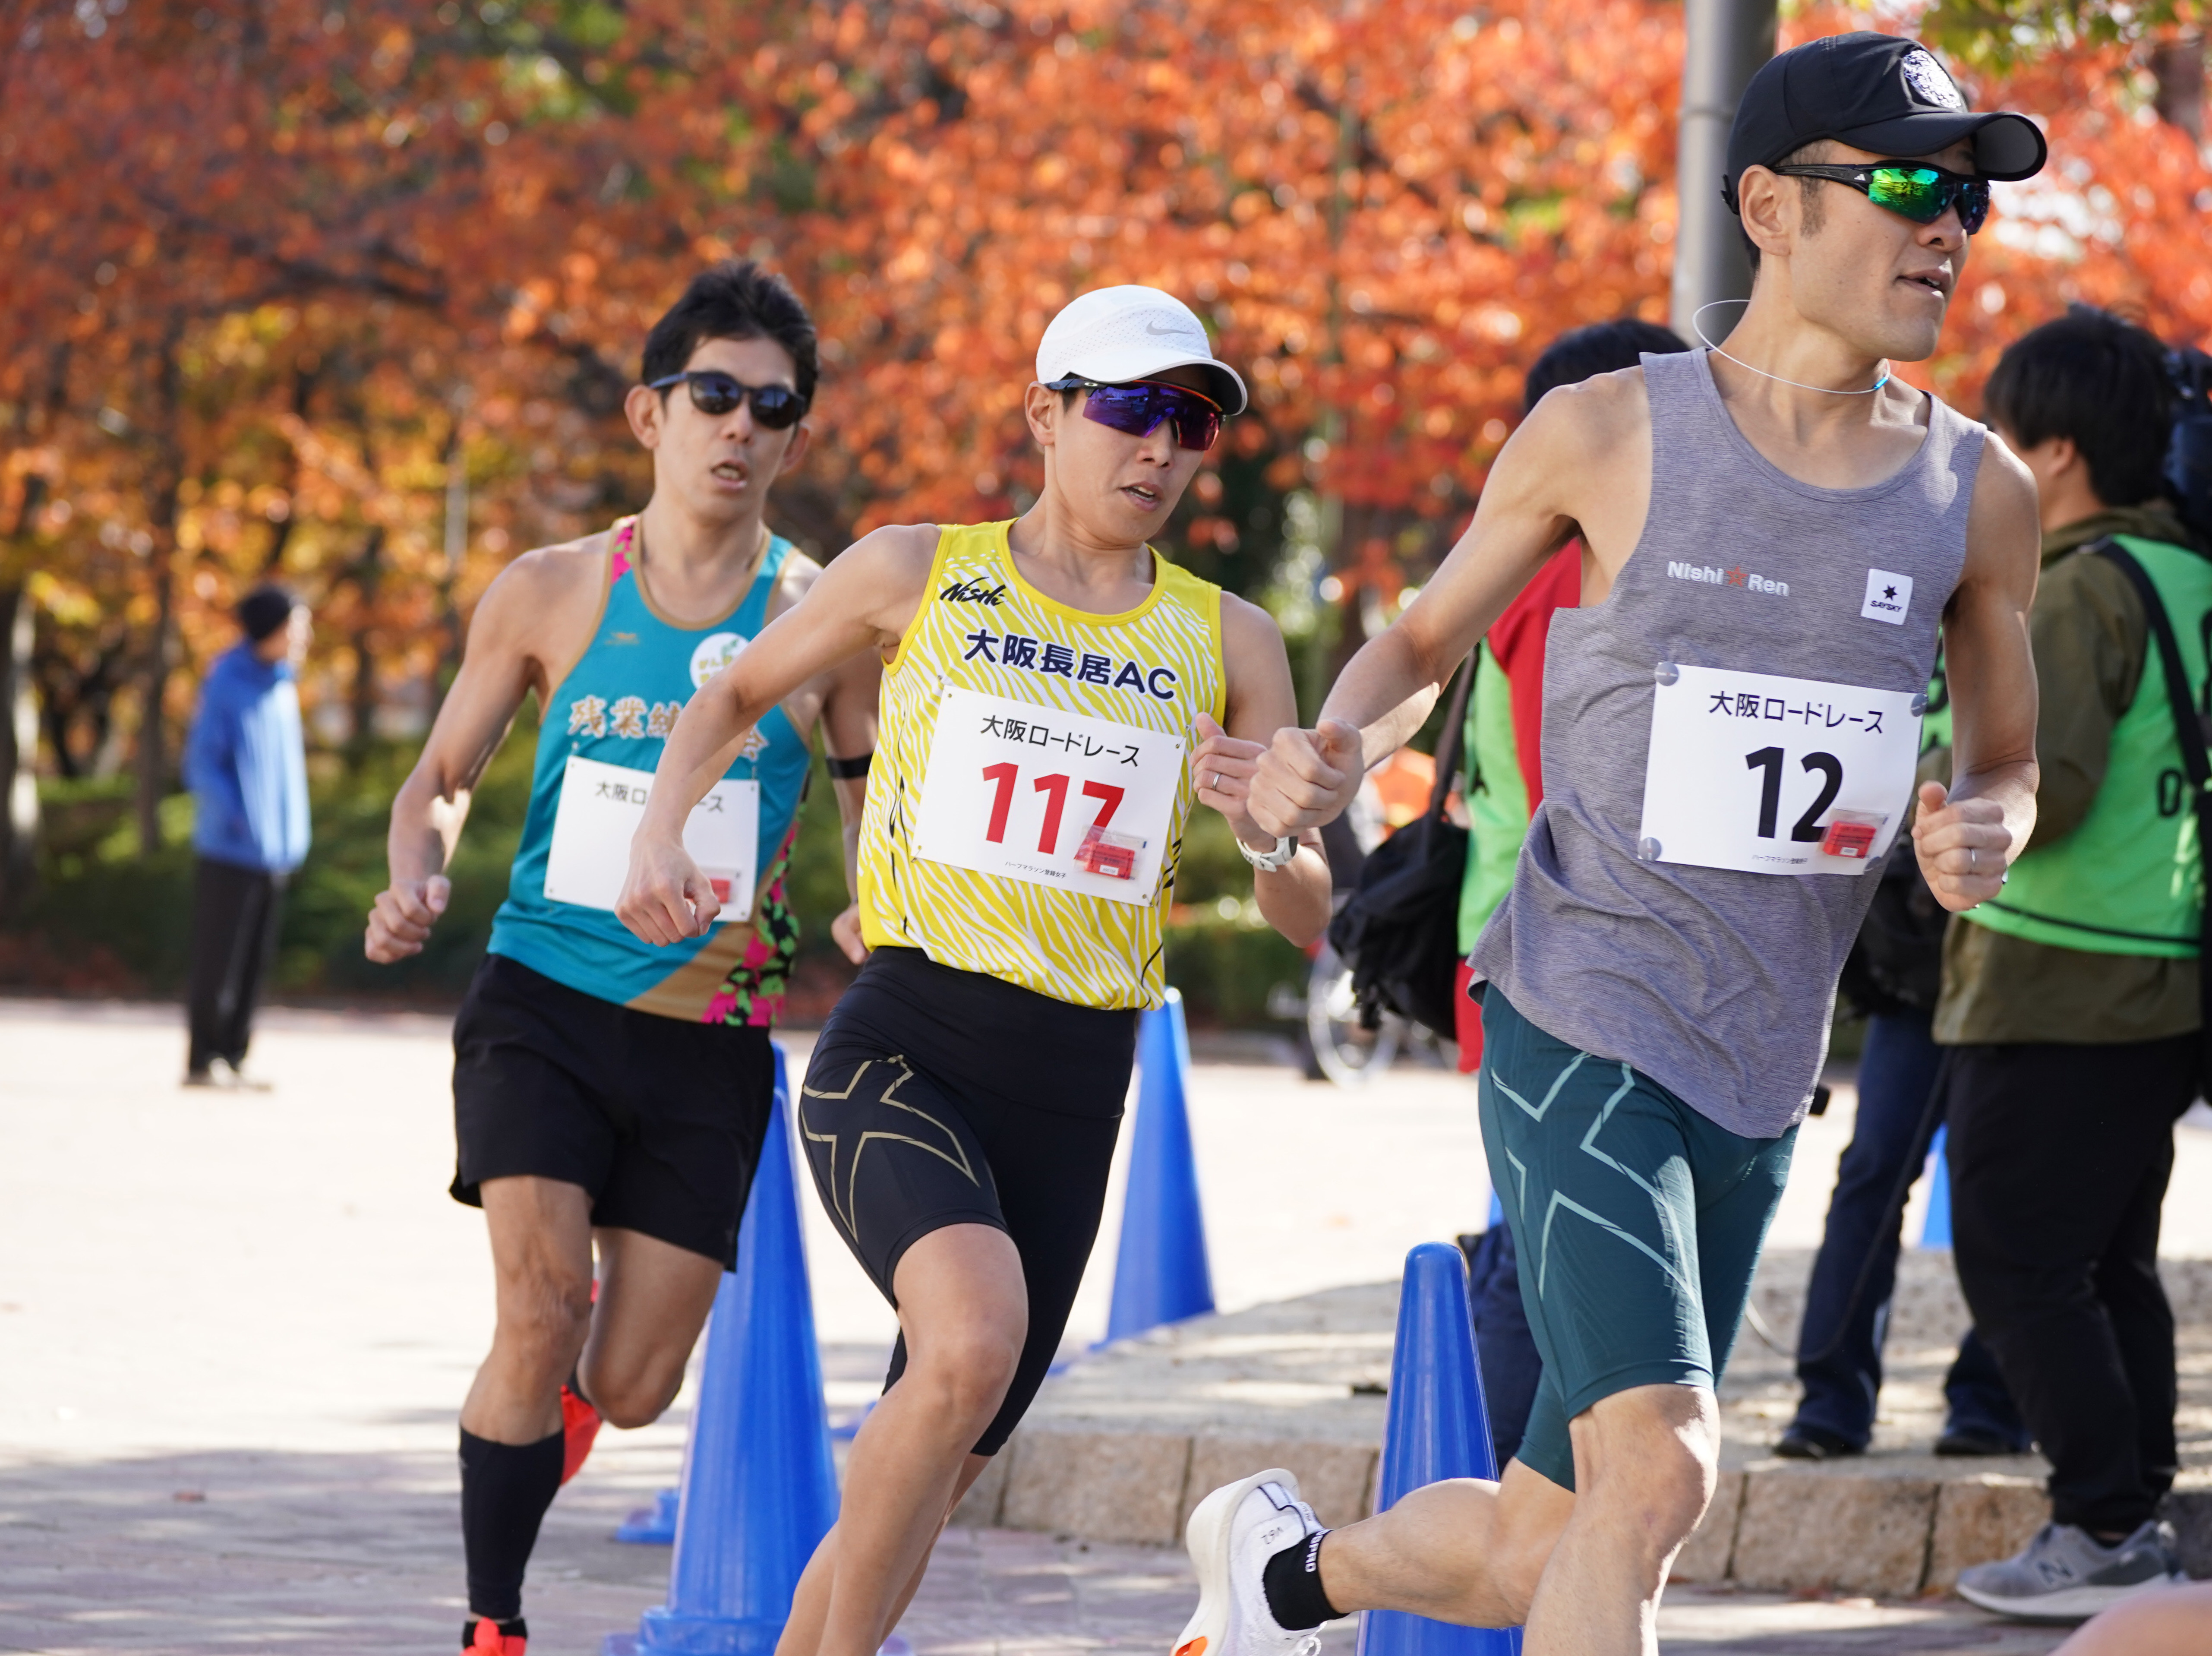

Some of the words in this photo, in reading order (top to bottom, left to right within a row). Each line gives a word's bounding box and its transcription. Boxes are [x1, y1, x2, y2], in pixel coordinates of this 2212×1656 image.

[1667, 561, 1725, 585] Nishi
[1748, 573, 1790, 597] Ren
[1869, 600, 1903, 613] SAYSKY
[964, 629, 1176, 699] 大阪長居AC
[1709, 690, 1884, 734] 大阪ロードレース
[980, 714, 1140, 767] 大阪ロードレース
[982, 762, 1125, 860] 117
[1745, 746, 1843, 843] 12
